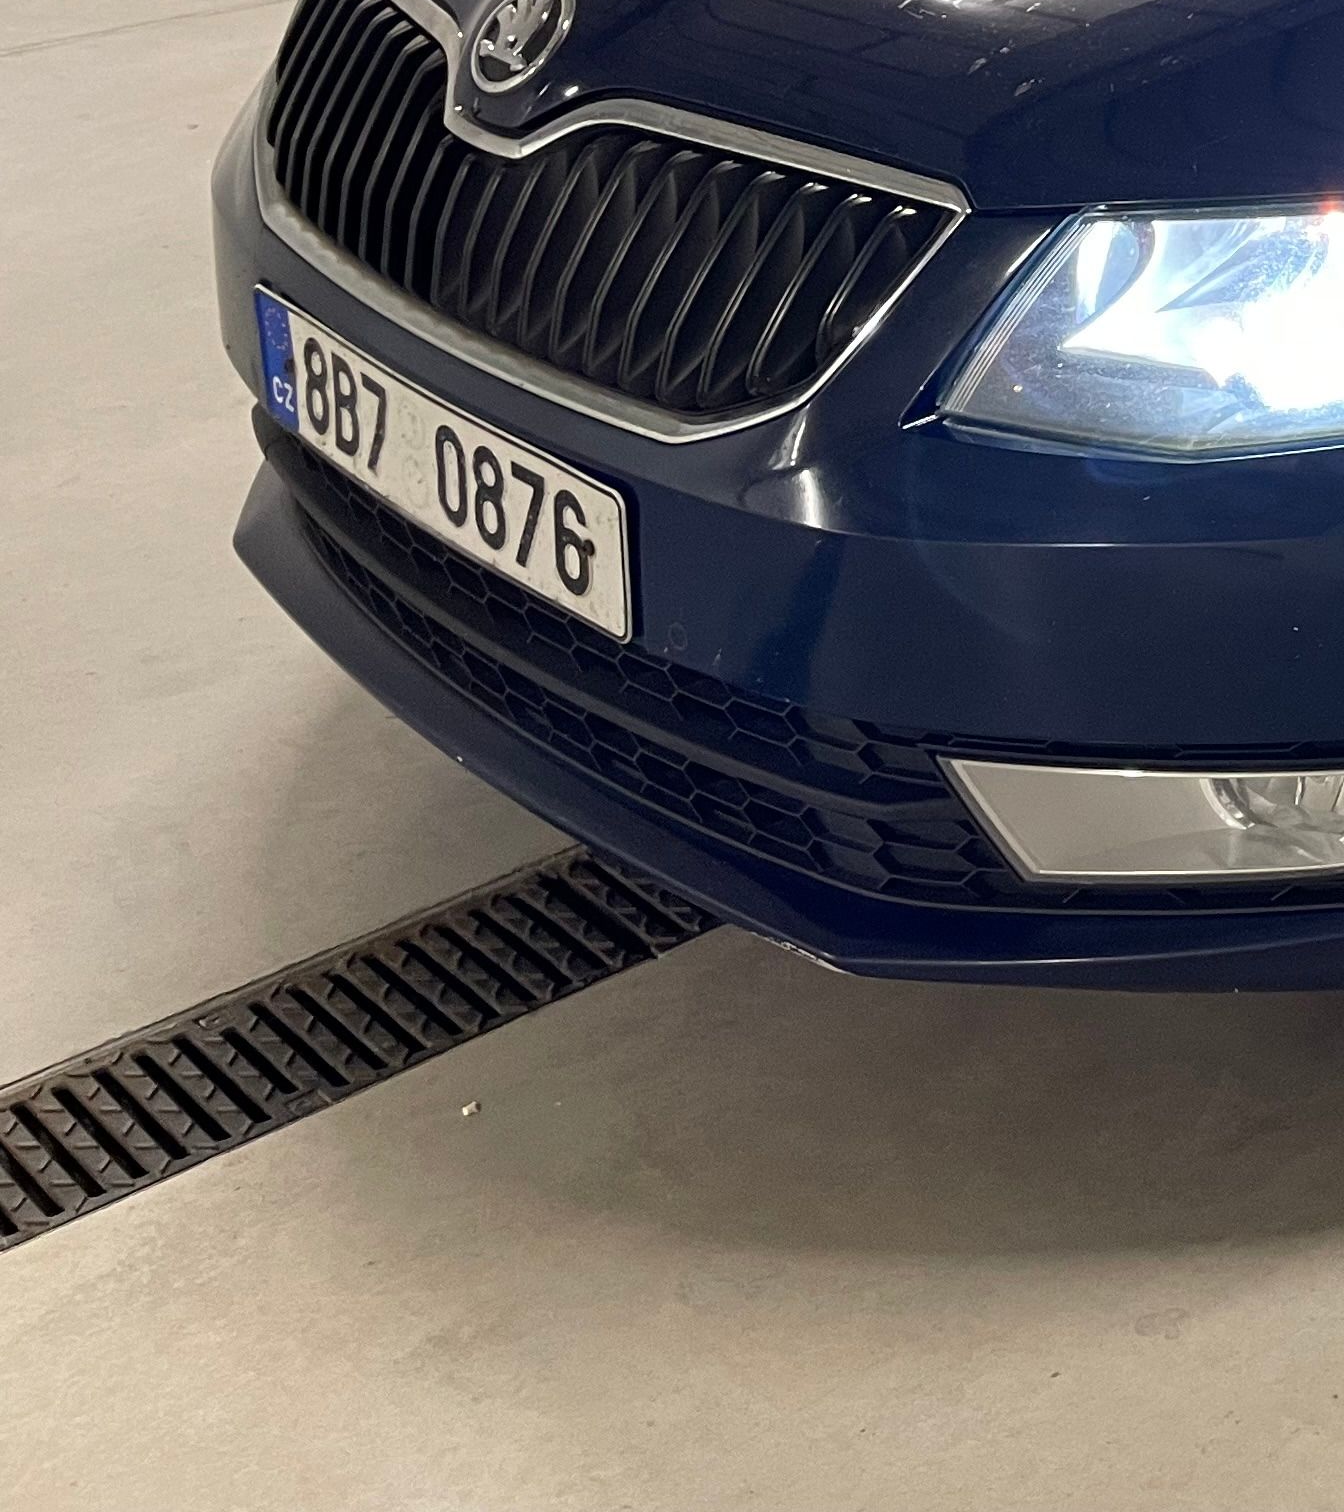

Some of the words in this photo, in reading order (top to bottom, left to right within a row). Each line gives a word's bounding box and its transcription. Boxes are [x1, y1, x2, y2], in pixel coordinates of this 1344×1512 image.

[272, 375, 295, 413] CZ
[303, 337, 387, 472] 8B7
[435, 424, 595, 596] 0876
